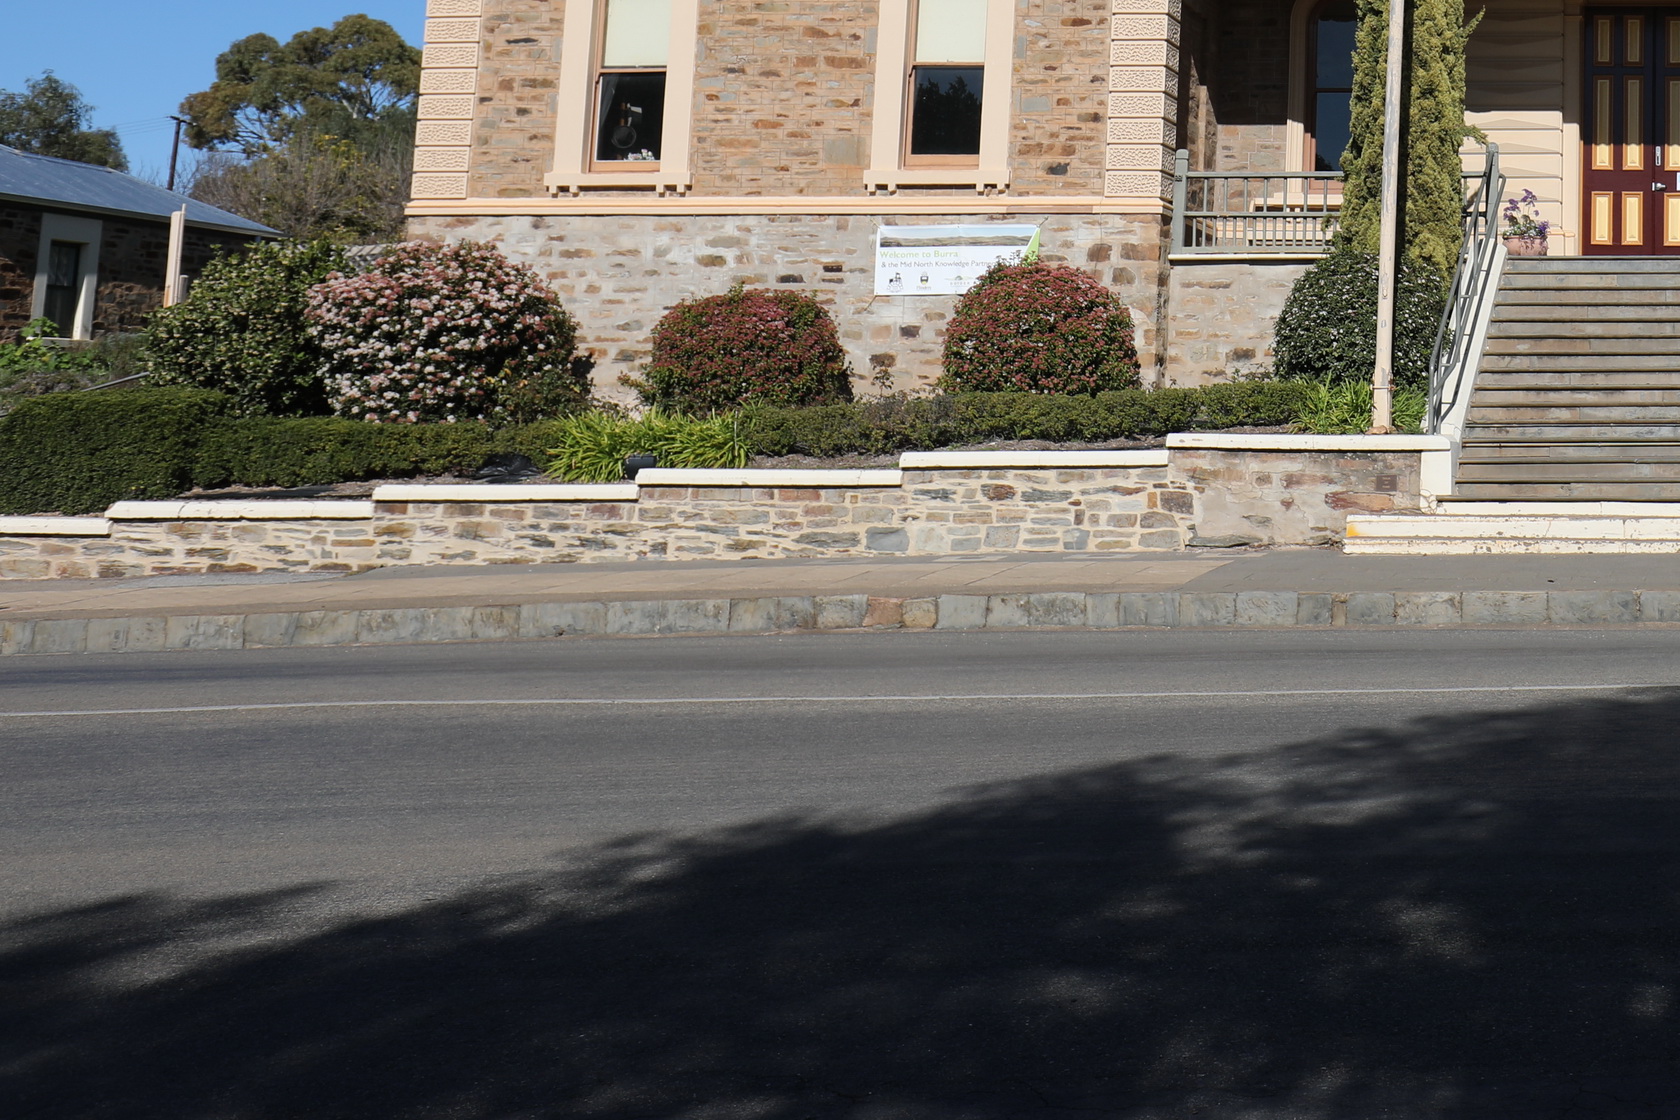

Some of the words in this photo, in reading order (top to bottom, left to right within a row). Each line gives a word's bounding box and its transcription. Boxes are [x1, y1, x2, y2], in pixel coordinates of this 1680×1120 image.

[880, 251, 920, 259] Welcome
[933, 250, 959, 258] Burra
[935, 260, 969, 268] Knowledge
